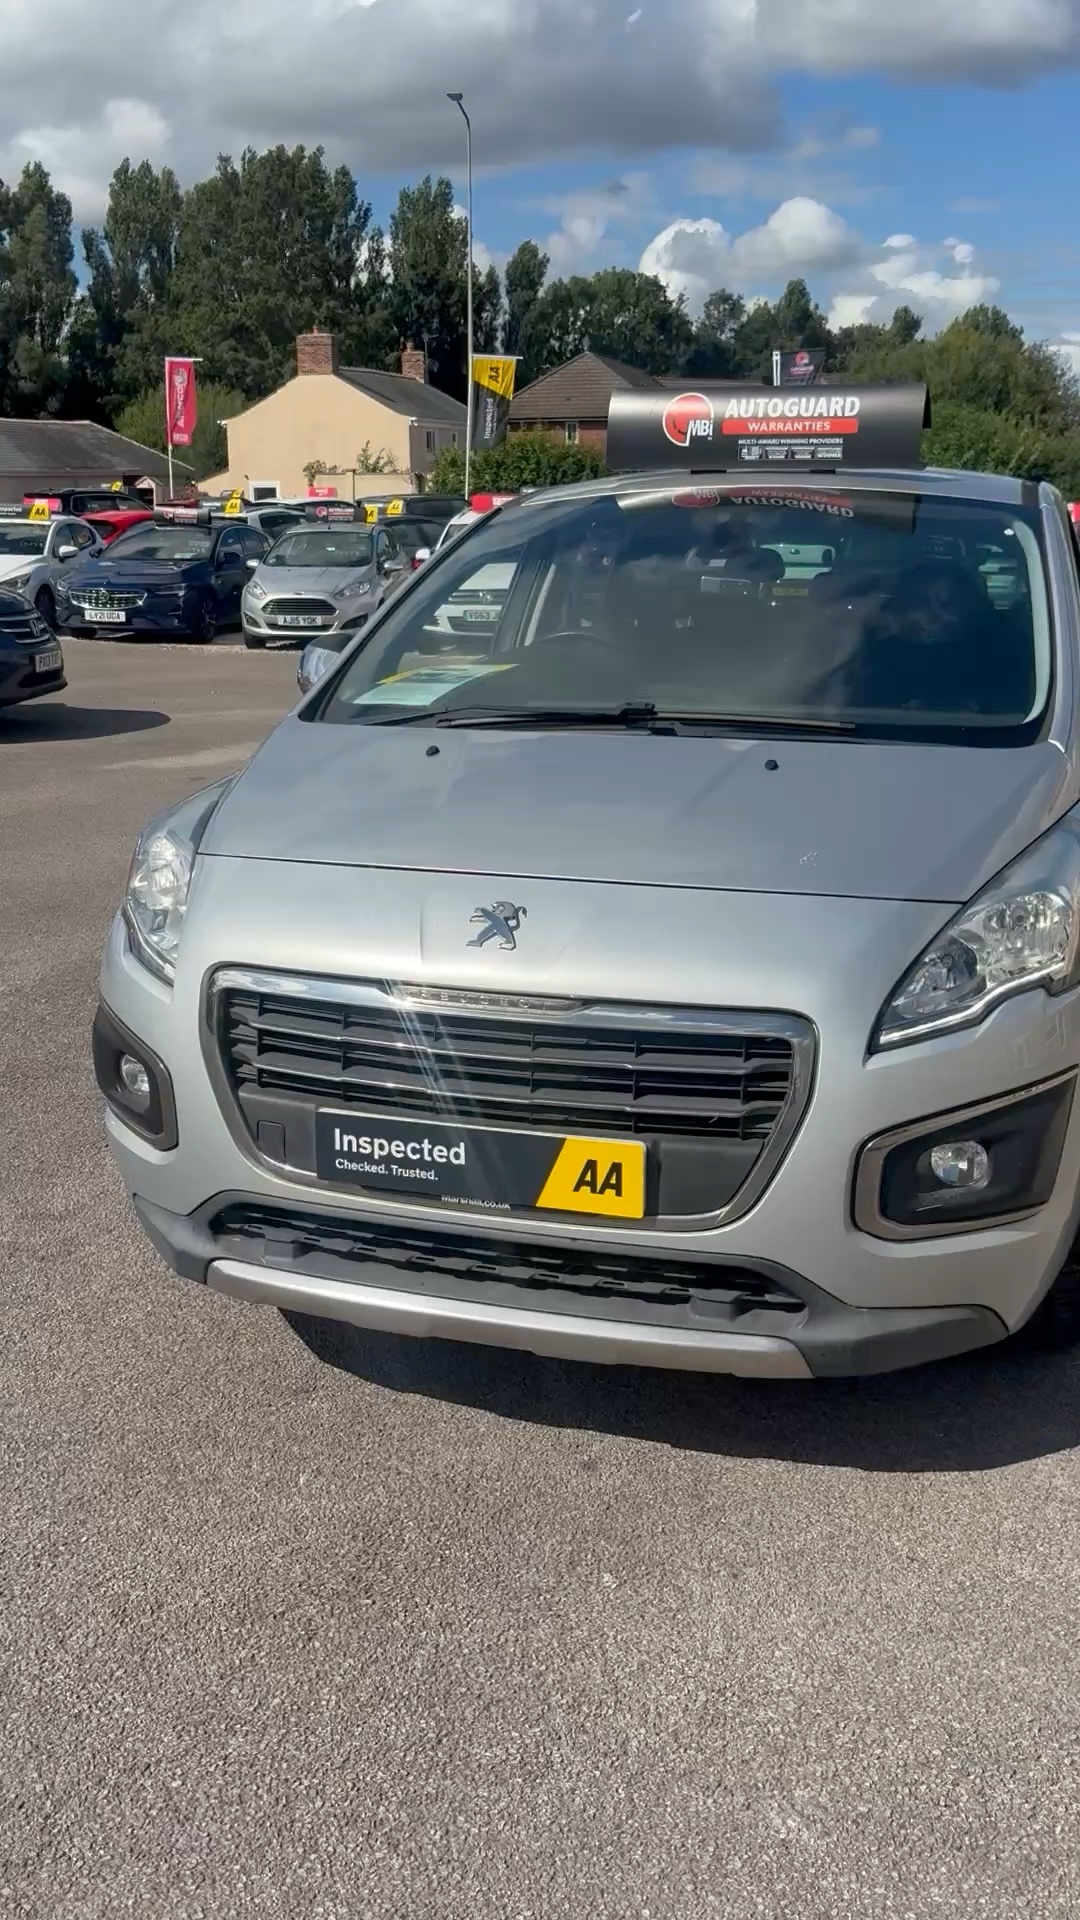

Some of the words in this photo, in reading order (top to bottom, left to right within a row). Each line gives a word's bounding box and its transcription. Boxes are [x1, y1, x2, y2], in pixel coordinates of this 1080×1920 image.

[724, 396, 861, 418] AUTOGUARD
[688, 418, 714, 437] MBi
[747, 420, 831, 432] WARRANTIES
[809, 436, 844, 444] PROVIDERS
[34, 507, 46, 516] AA
[334, 1128, 466, 1165] Inspected
[335, 1158, 389, 1174] Checked.
[391, 1165, 439, 1180] Trusted.
[572, 1159, 623, 1197] AA
